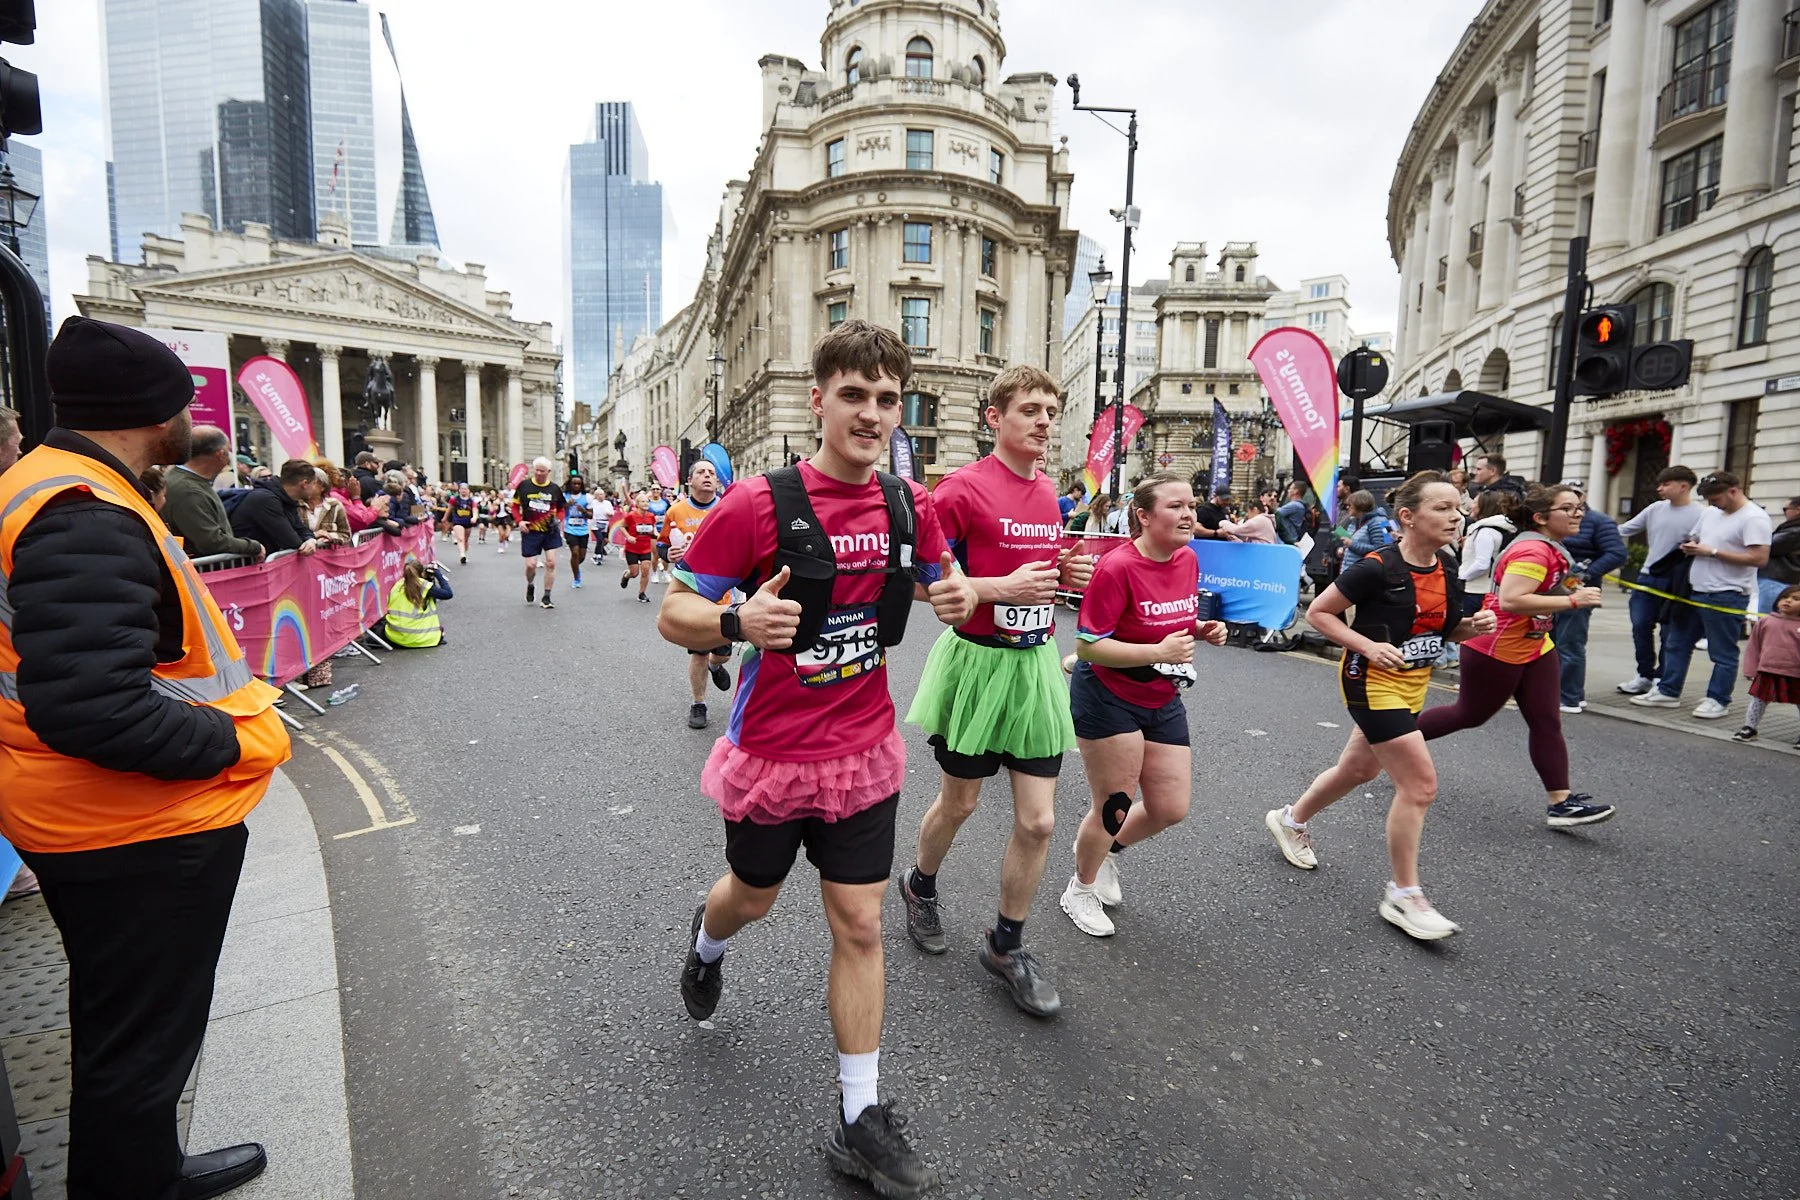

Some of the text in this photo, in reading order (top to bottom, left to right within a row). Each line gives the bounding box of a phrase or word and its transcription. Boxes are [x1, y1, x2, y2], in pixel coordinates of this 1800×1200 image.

[999, 518, 1064, 541] Tommy's
[852, 560, 867, 568] and
[1204, 574, 1250, 588] Kingston
[1253, 579, 1286, 594] Smith
[1139, 593, 1199, 616] Tommy's
[827, 611, 864, 626] NATHAN
[1006, 607, 1051, 627] 9717
